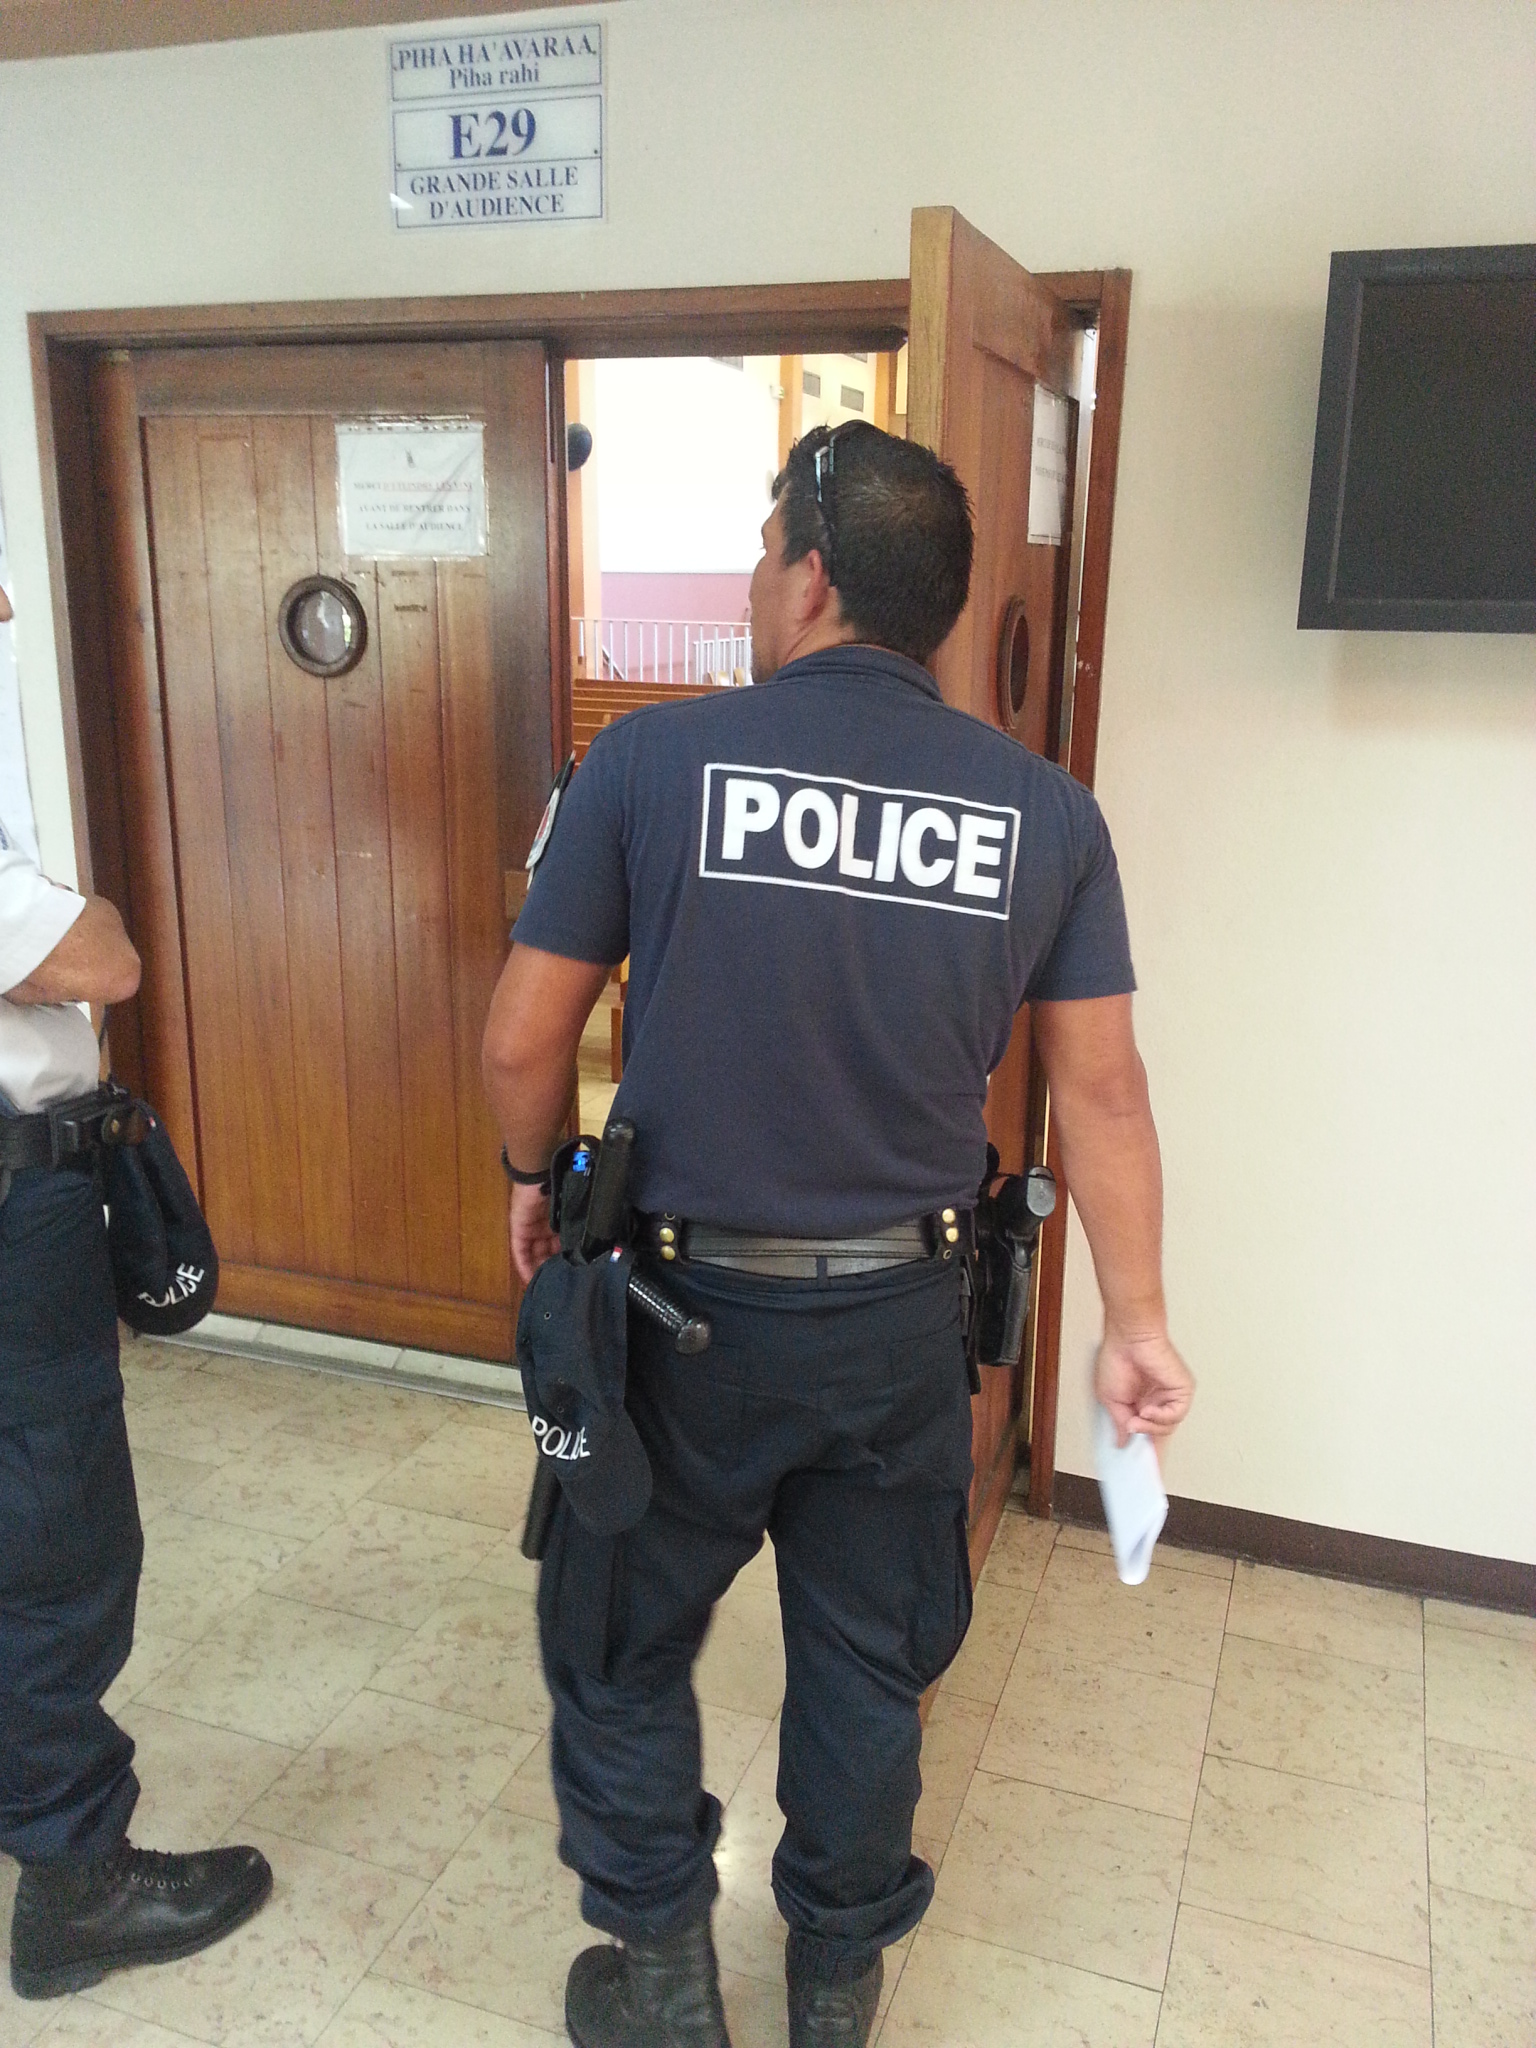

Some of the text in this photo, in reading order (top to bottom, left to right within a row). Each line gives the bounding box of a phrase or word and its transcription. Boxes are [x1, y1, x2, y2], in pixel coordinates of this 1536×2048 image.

[398, 46, 452, 70] PIHA
[450, 62, 540, 89] Piha rahi
[449, 107, 537, 160] E29
[410, 165, 578, 194] GRANDE SALLE
[429, 193, 564, 220] D'AUDIENCE
[721, 777, 1007, 899] POLICE
